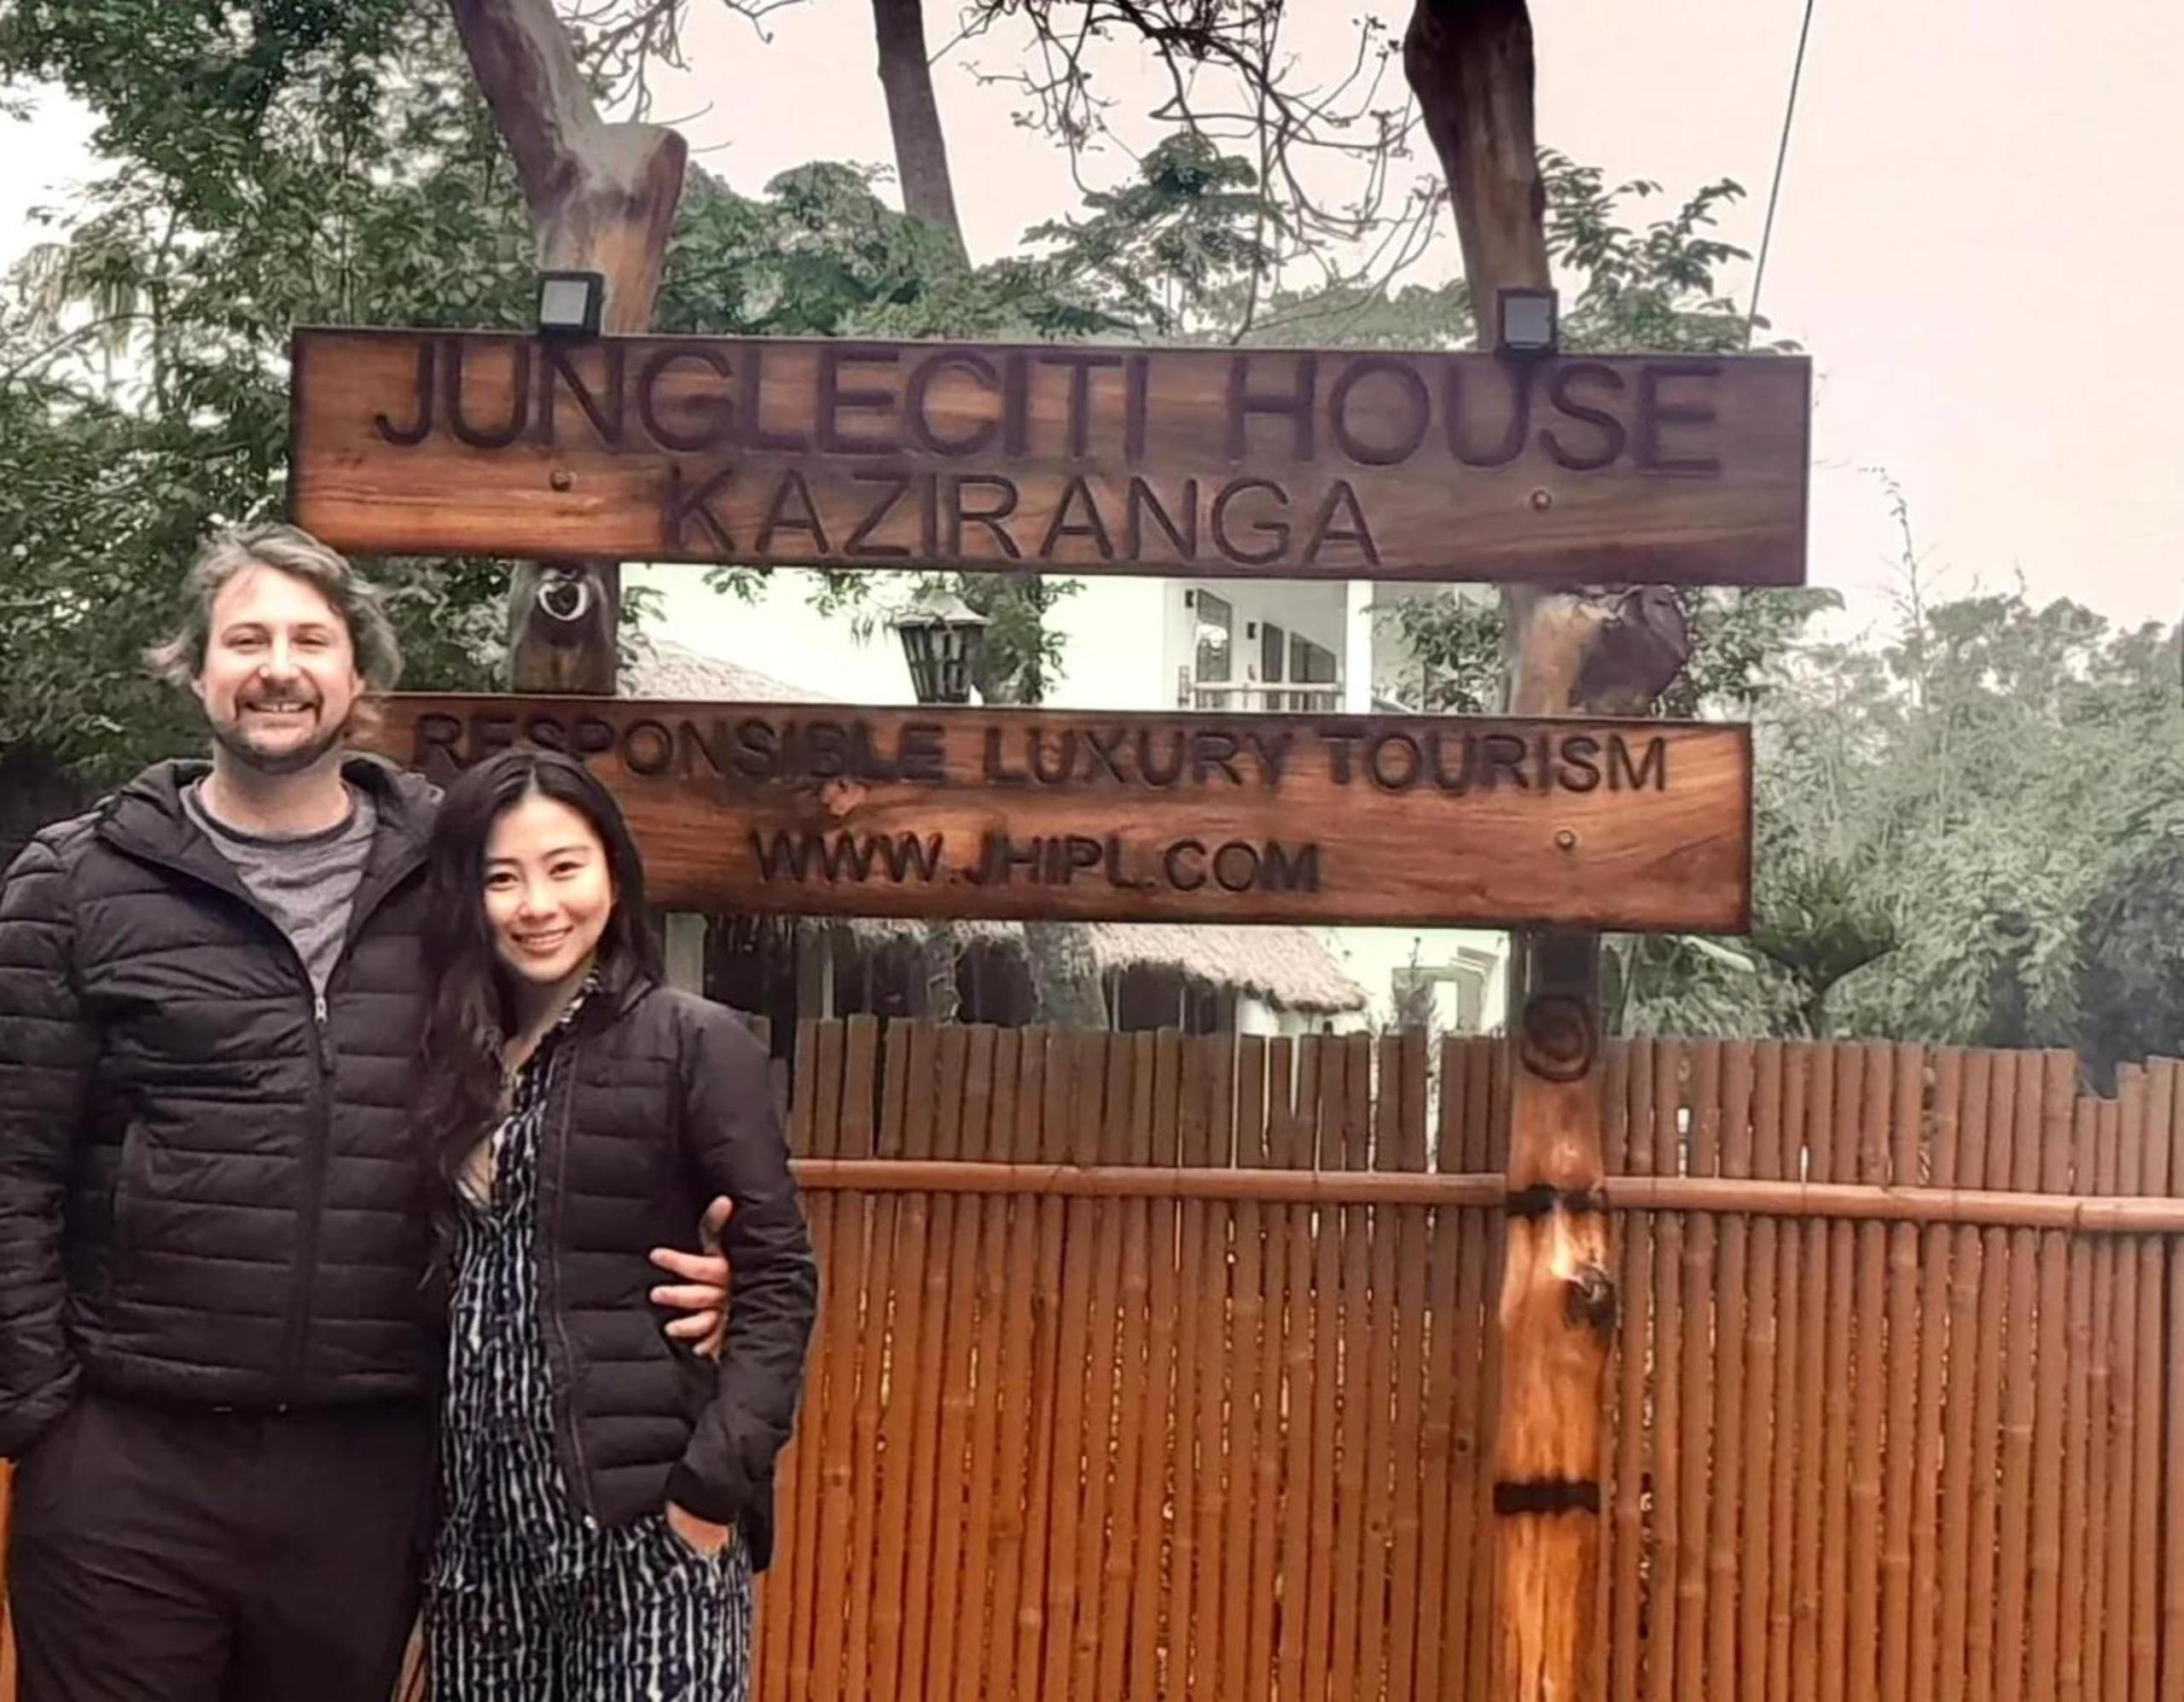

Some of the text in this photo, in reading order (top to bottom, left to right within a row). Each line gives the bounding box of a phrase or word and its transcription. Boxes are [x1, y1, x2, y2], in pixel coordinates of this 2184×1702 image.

[374, 340, 1722, 476] JUNGLECITI HOUSE
[661, 466, 1382, 566] KAZIRANGA
[415, 712, 1668, 795] RESPONSIBLE LUXURY TOURISM
